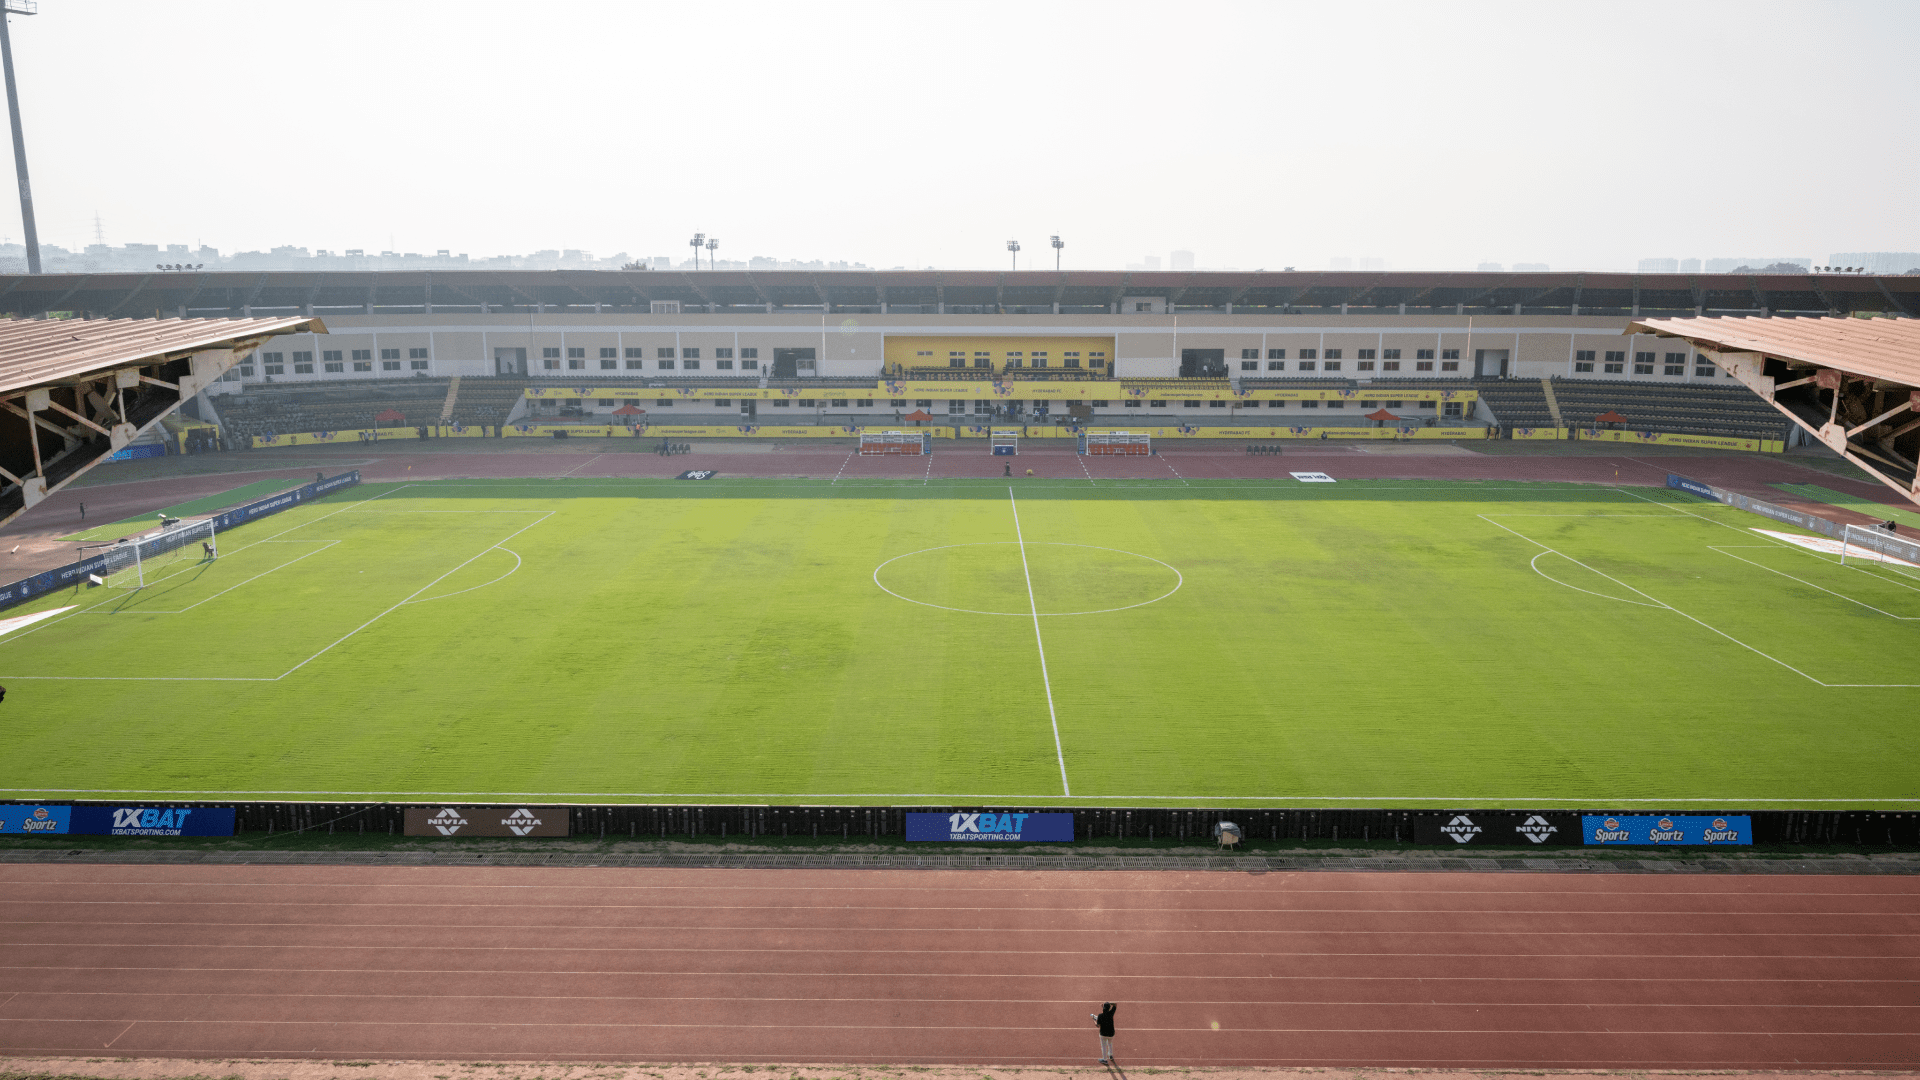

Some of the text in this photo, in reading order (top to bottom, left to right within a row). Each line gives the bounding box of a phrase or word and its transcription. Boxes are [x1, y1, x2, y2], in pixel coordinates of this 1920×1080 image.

[112, 808, 191, 828] 1XBAT
[949, 813, 1029, 832] 1XBAT
[23, 818, 57, 833] Sportz
[111, 828, 182, 836] 1XBATSPORTING.COM
[949, 833, 1021, 841] 1XBATSPORTING.COM
[1595, 829, 1630, 843] Sportz
[1649, 829, 1684, 843] Sportz
[1703, 829, 1738, 843] Sportz
